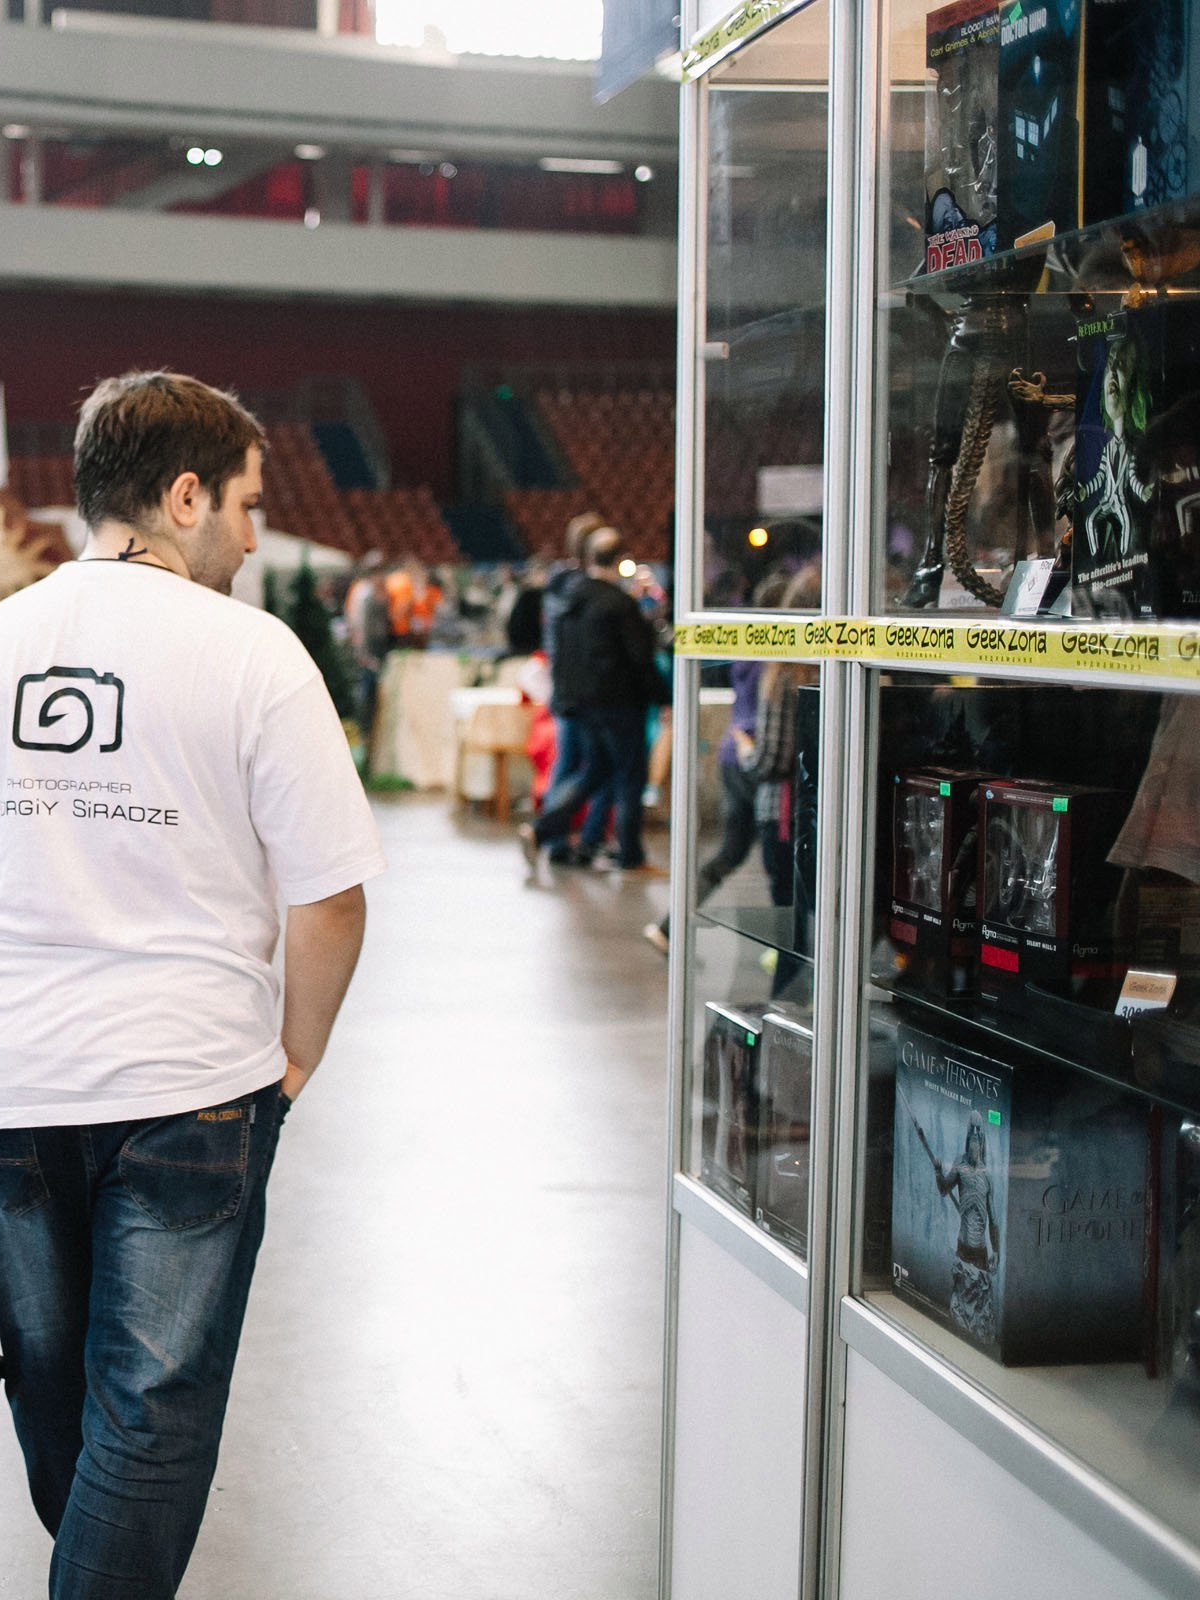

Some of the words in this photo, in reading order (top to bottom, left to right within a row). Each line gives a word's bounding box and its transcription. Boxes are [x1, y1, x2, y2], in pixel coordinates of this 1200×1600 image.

[1001, 17, 1028, 47] DOCTOR
[1029, 8, 1047, 33] WHO
[945, 225, 979, 242] WALKING
[928, 239, 982, 275] DEAD
[1078, 573, 1090, 584] The
[902, 1041, 937, 1075] GAME
[944, 1056, 1001, 1101] THRONES
